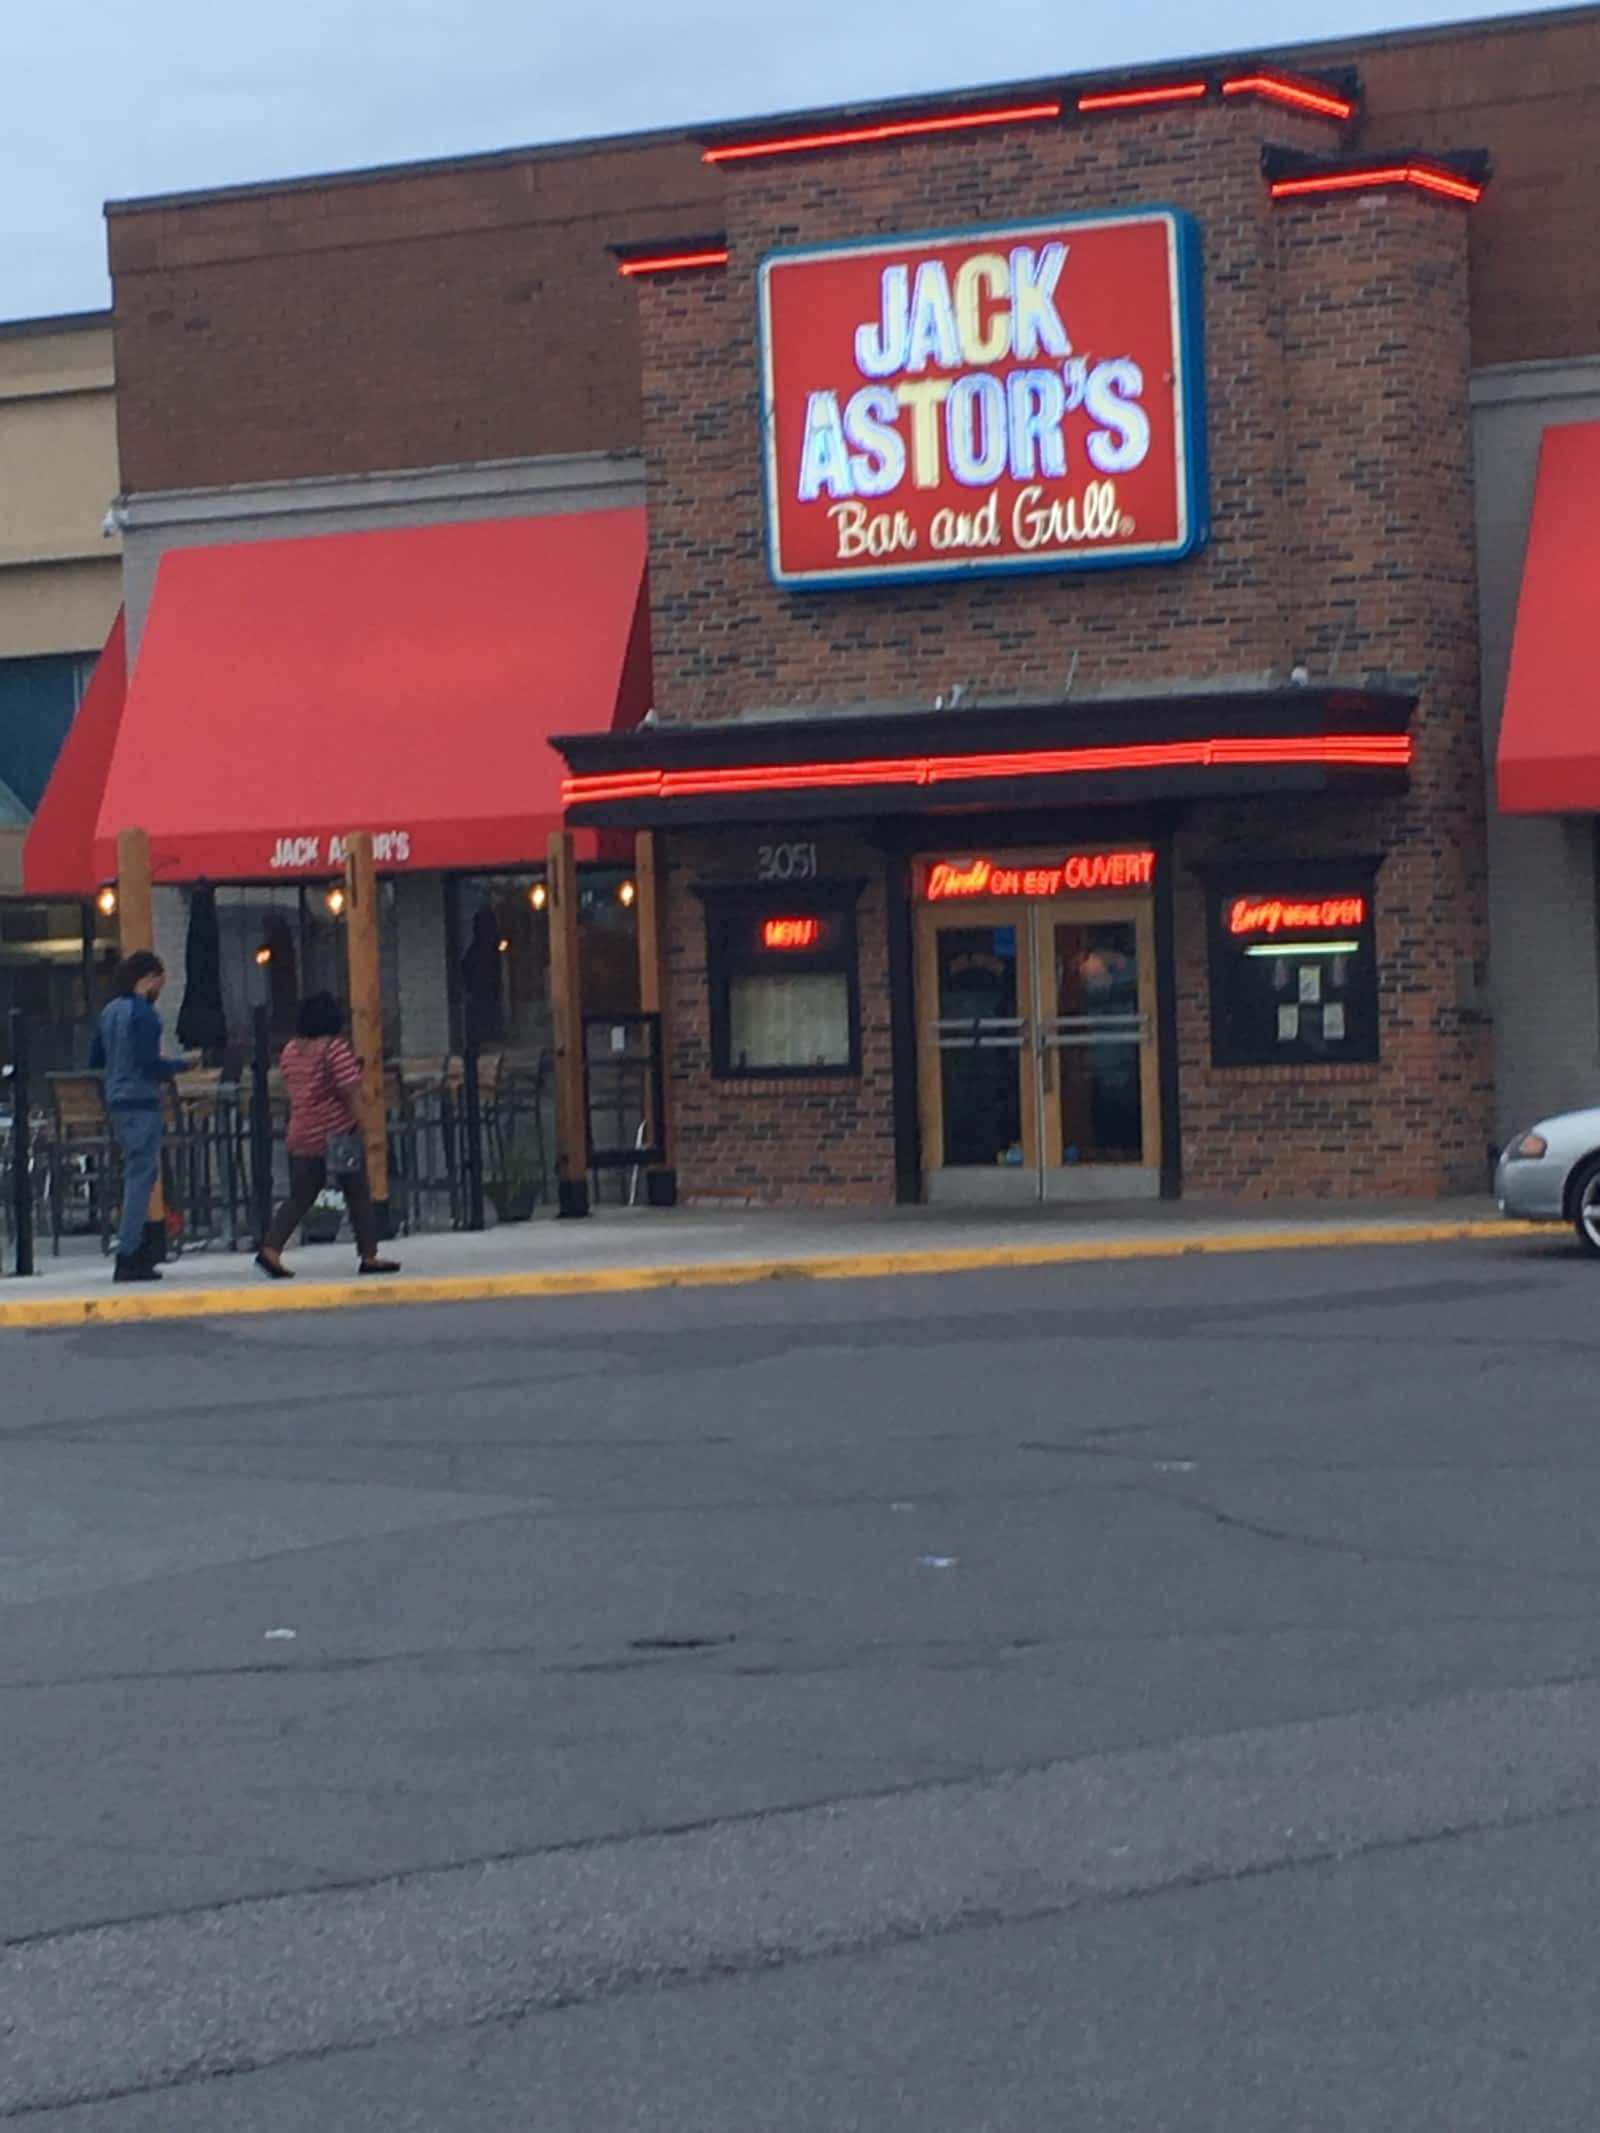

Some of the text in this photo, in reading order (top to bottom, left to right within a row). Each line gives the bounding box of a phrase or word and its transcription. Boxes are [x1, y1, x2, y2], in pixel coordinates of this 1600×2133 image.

[854, 242, 1073, 377] JACK
[797, 353, 1151, 501] ASTOR'S
[828, 479, 1122, 558] Bar and Grill
[270, 830, 409, 868] JACK ASR'S
[1065, 852, 1154, 888] OUVERT
